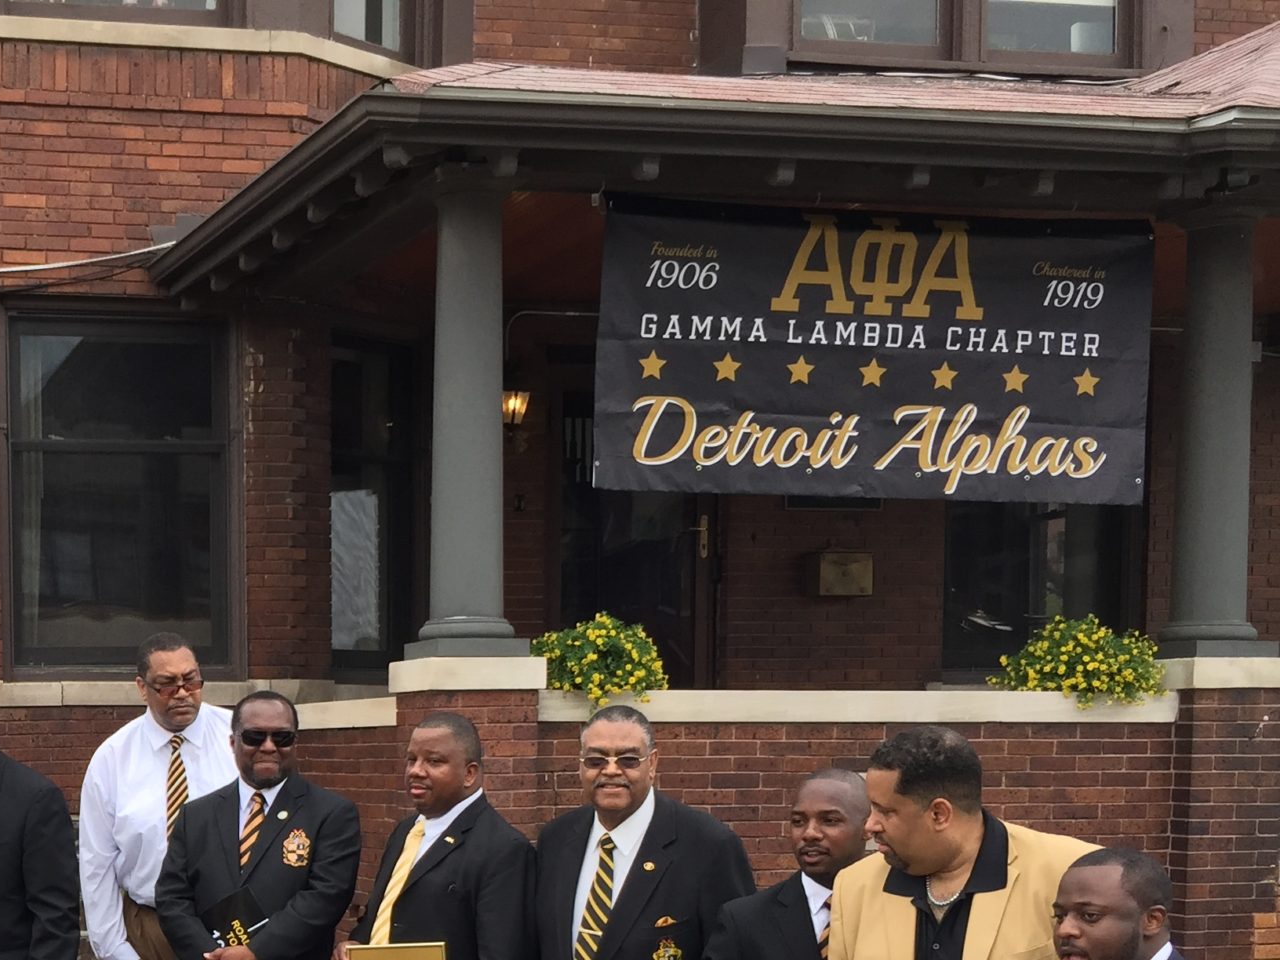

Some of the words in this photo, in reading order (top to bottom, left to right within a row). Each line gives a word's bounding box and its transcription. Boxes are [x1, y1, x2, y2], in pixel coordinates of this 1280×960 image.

[650, 241, 705, 257] Founded
[706, 246, 719, 258] in
[645, 259, 720, 290] 1906
[1032, 261, 1092, 279] Chartered
[1094, 268, 1106, 279] in
[1043, 280, 1105, 309] 1919
[640, 313, 768, 343] GAMMA
[787, 320, 927, 350] LAMBDA
[945, 326, 1101, 358] CHAPTER
[631, 394, 861, 469] Detroit
[874, 403, 1108, 494] Alphas
[226, 930, 238, 946] TO
